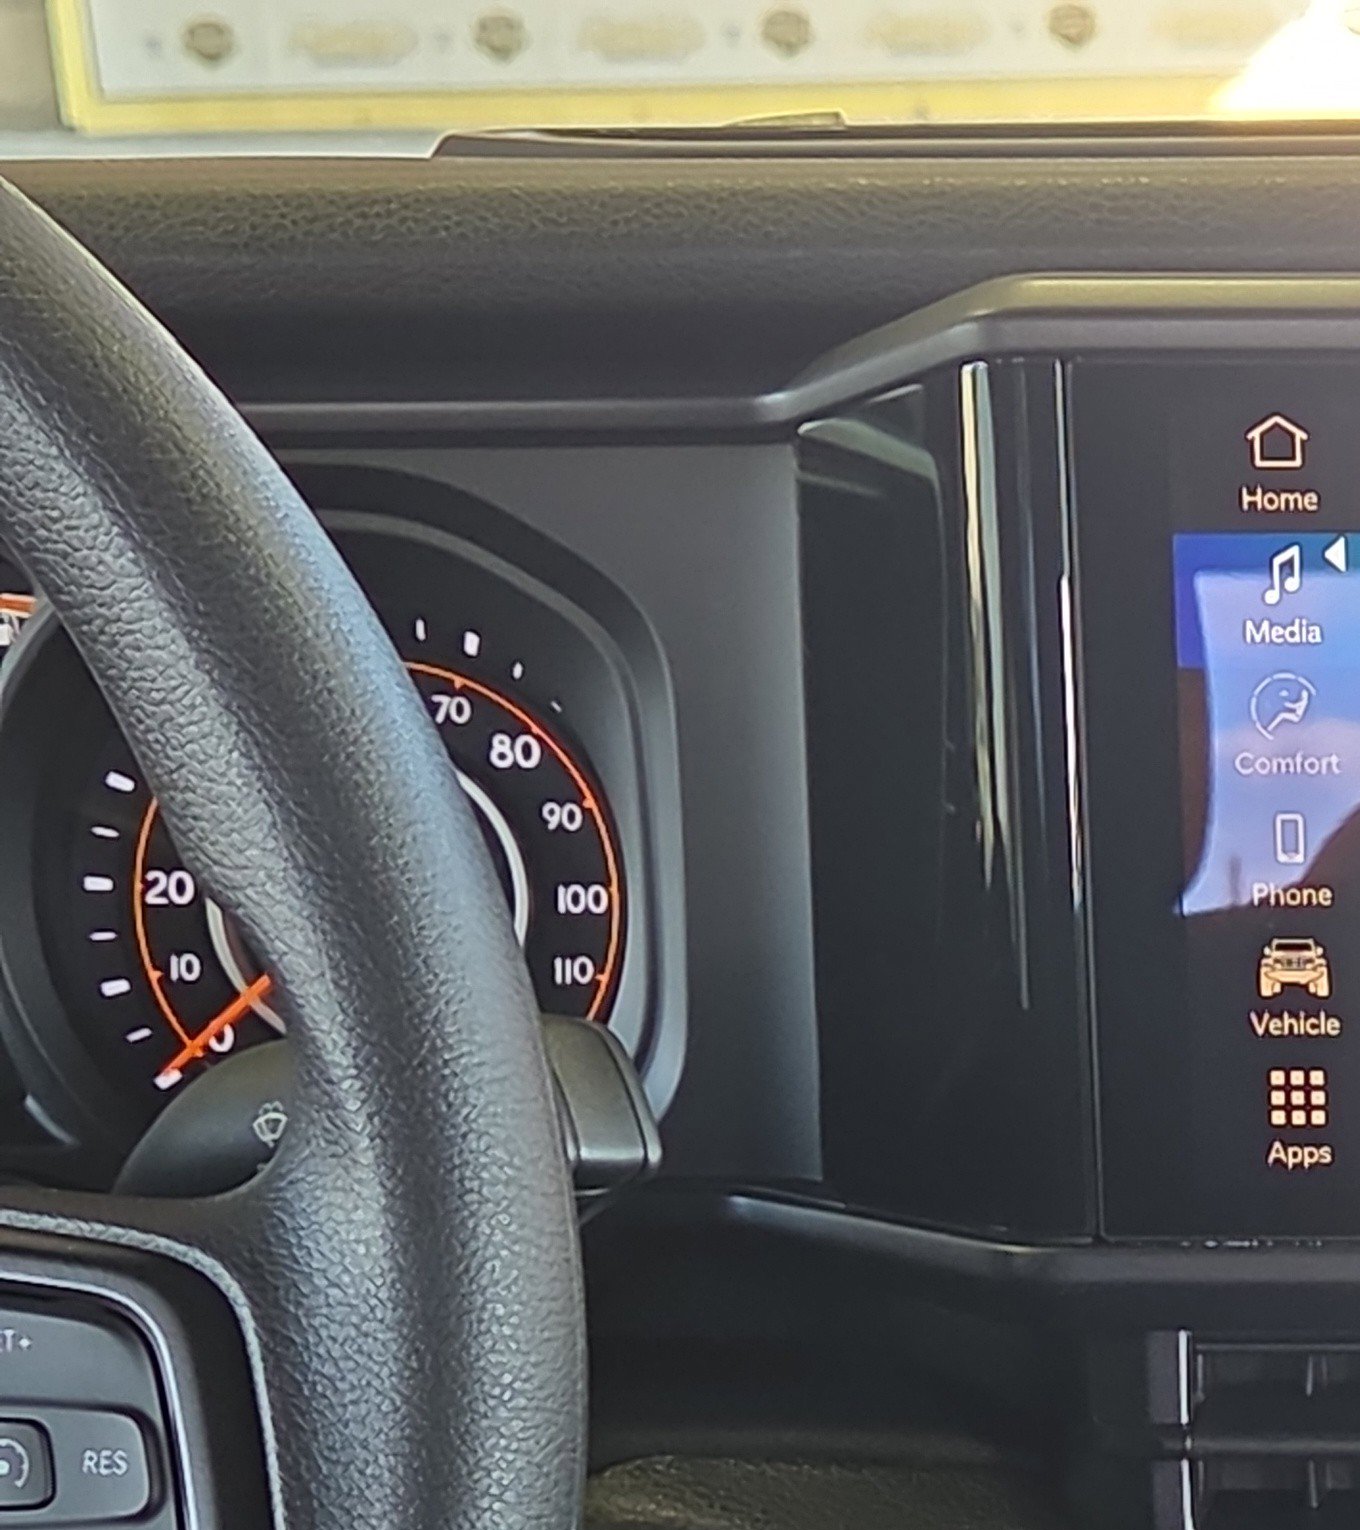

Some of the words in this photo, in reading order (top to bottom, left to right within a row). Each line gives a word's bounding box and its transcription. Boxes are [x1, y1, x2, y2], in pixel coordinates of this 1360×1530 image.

[1241, 487, 1319, 512] Home
[1245, 619, 1323, 645] Media
[431, 696, 471, 725] 70
[489, 734, 542, 769] 80
[1235, 752, 1341, 775] Comfort
[541, 803, 582, 832] 90
[144, 871, 196, 905] 20
[557, 885, 608, 915] 100
[1252, 882, 1333, 907] Phone
[168, 955, 201, 982] 10
[553, 957, 594, 986] 110
[1249, 1011, 1342, 1037] Vehicle
[1267, 1143, 1333, 1168] Apps
[81, 1449, 128, 1476] RES
